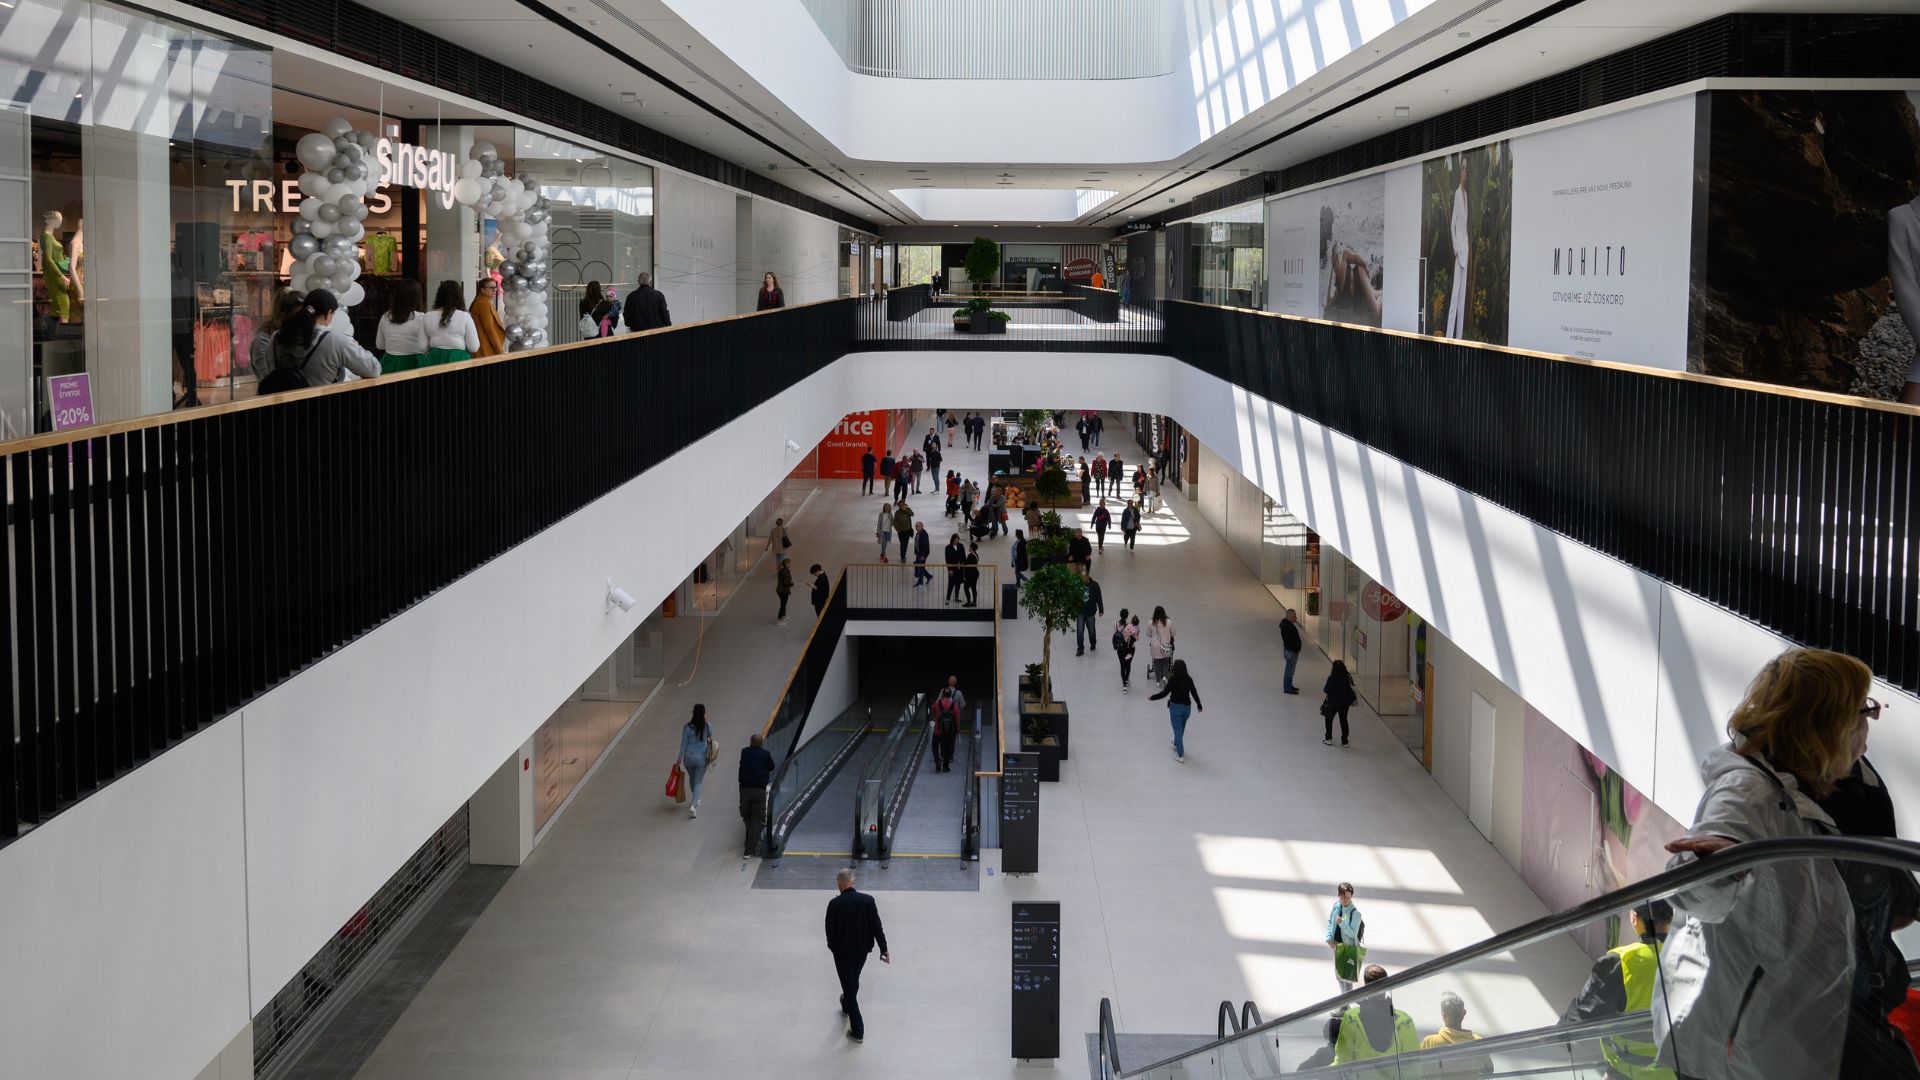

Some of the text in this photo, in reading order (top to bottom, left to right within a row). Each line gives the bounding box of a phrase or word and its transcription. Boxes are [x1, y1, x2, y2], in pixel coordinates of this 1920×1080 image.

[377, 137, 456, 210] sinsay
[225, 179, 392, 214] TRES
[1553, 245, 1626, 276] MOHITO
[60, 381, 78, 389] PROMO
[57, 407, 90, 426] -20%
[826, 440, 868, 448] Great brands
